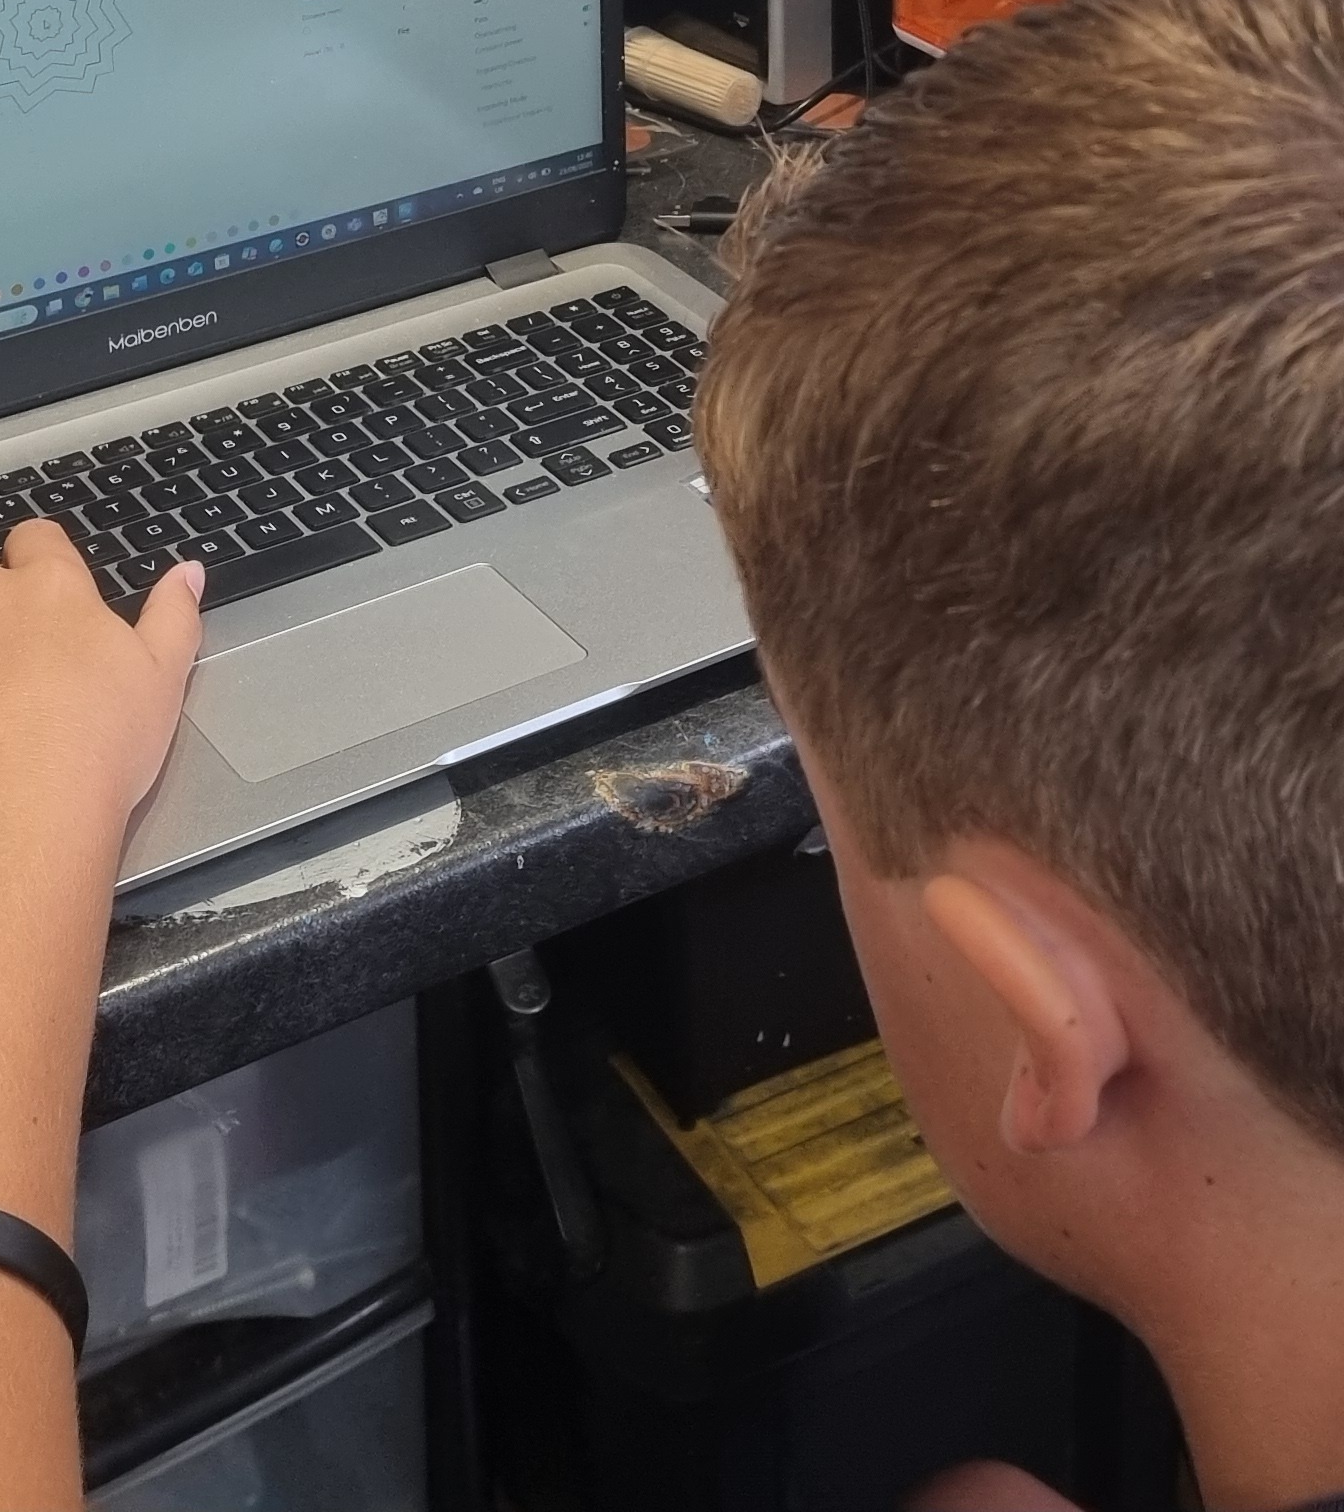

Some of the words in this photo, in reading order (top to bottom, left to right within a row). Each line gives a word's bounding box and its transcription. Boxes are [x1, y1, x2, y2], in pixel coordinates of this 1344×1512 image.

[108, 309, 218, 354] Maibenben
[244, 398, 259, 407] F10
[290, 384, 305, 393] F11
[336, 370, 351, 379] F12
[384, 354, 409, 364] Pause
[49, 493, 64, 504] 5
[108, 474, 122, 484] 6
[164, 456, 177, 467] 7
[222, 439, 236, 449] 8
[277, 422, 291, 432] 9
[476, 344, 528, 365] Backspace
[86, 543, 100, 556] F
[145, 525, 163, 537] G
[205, 505, 222, 518] H
[265, 487, 279, 499] J
[317, 469, 335, 480] K
[372, 453, 389, 464] L
[553, 389, 579, 403] Enter
[106, 502, 121, 514] T
[164, 484, 179, 496] Y
[221, 466, 239, 478] U
[280, 450, 290, 460] I
[331, 431, 348, 443] O
[384, 415, 398, 427] P
[140, 560, 156, 572] V
[201, 541, 219, 553] B
[259, 522, 278, 535] N
[315, 503, 336, 516] M
[582, 413, 610, 427] Shift
[399, 515, 418, 526] Alt
[453, 488, 476, 501] Ctrl
